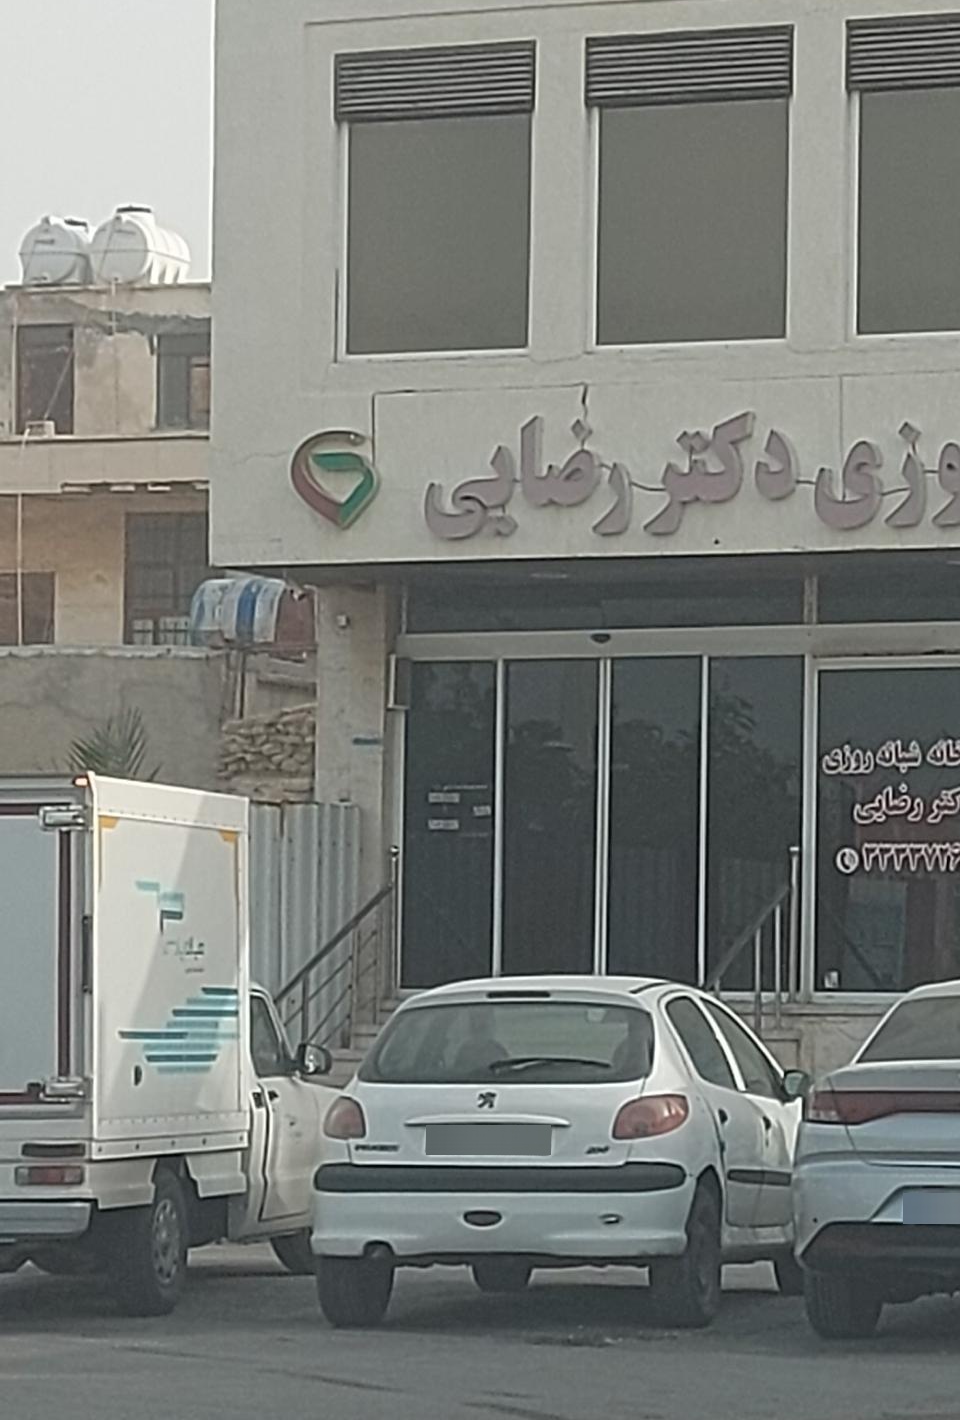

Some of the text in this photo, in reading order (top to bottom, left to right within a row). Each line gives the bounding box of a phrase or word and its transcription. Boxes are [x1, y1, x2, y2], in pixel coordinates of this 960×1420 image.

[424, 415, 632, 540] رضایی
[643, 411, 799, 536] دکتر
[822, 744, 875, 774] روزی
[875, 740, 922, 773] شبانه
[853, 782, 924, 825] رضایی
